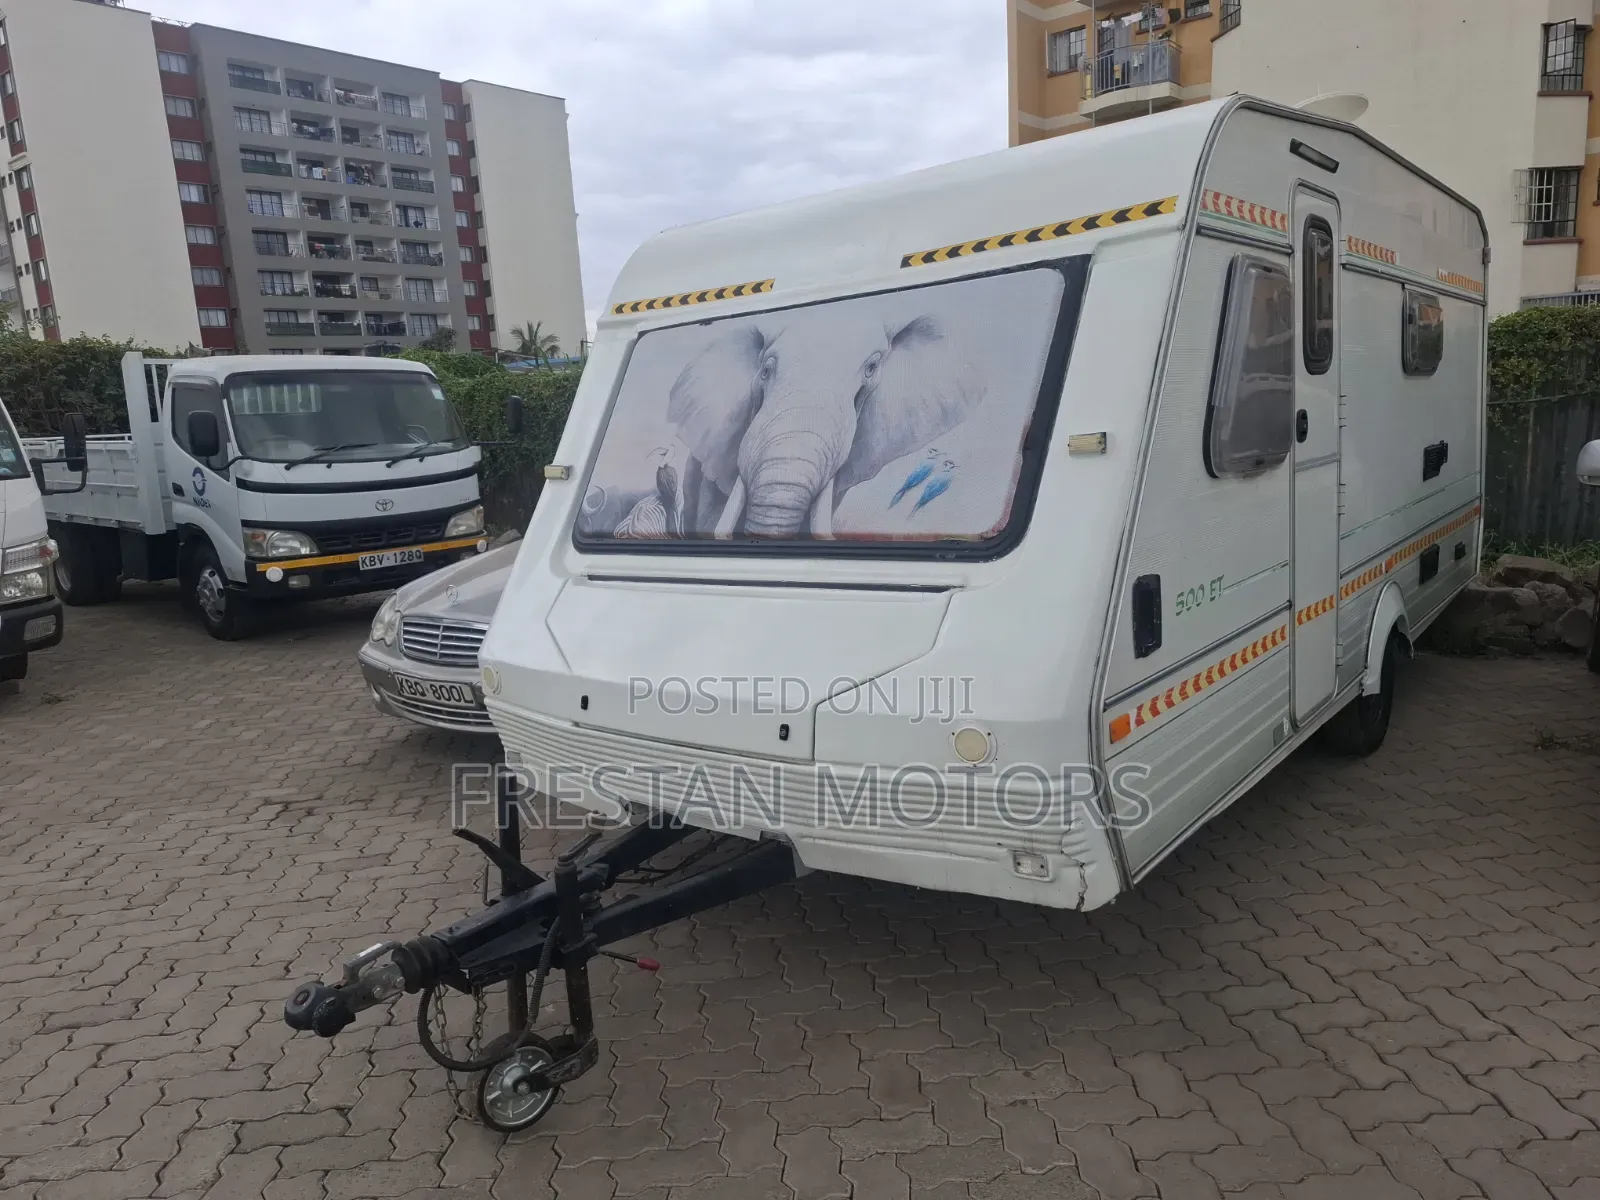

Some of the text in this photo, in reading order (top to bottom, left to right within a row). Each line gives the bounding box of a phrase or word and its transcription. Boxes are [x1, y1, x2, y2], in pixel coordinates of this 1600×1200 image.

[360, 554, 385, 569] KBV
[1175, 573, 1225, 617] 500 ET
[396, 676, 475, 704] KBQ 800L
